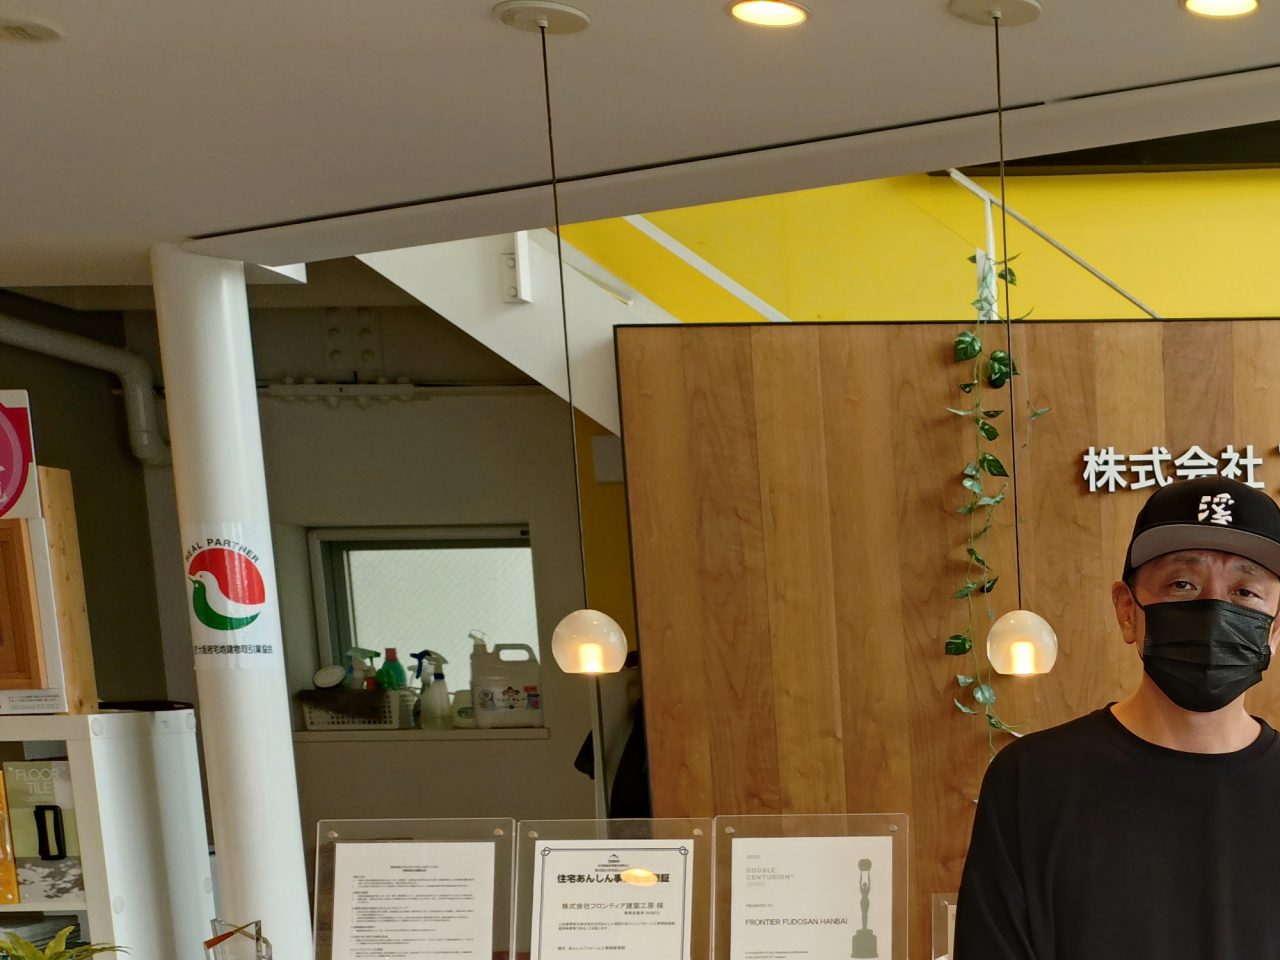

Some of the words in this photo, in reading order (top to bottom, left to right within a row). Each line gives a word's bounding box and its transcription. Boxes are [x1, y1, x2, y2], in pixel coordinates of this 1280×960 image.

[206, 538, 260, 563] PARTNER
[15, 768, 59, 781] FLOOR
[26, 782, 53, 794] TILE
[745, 918, 780, 926] FRONTIER
[820, 917, 848, 925] HANBAI
